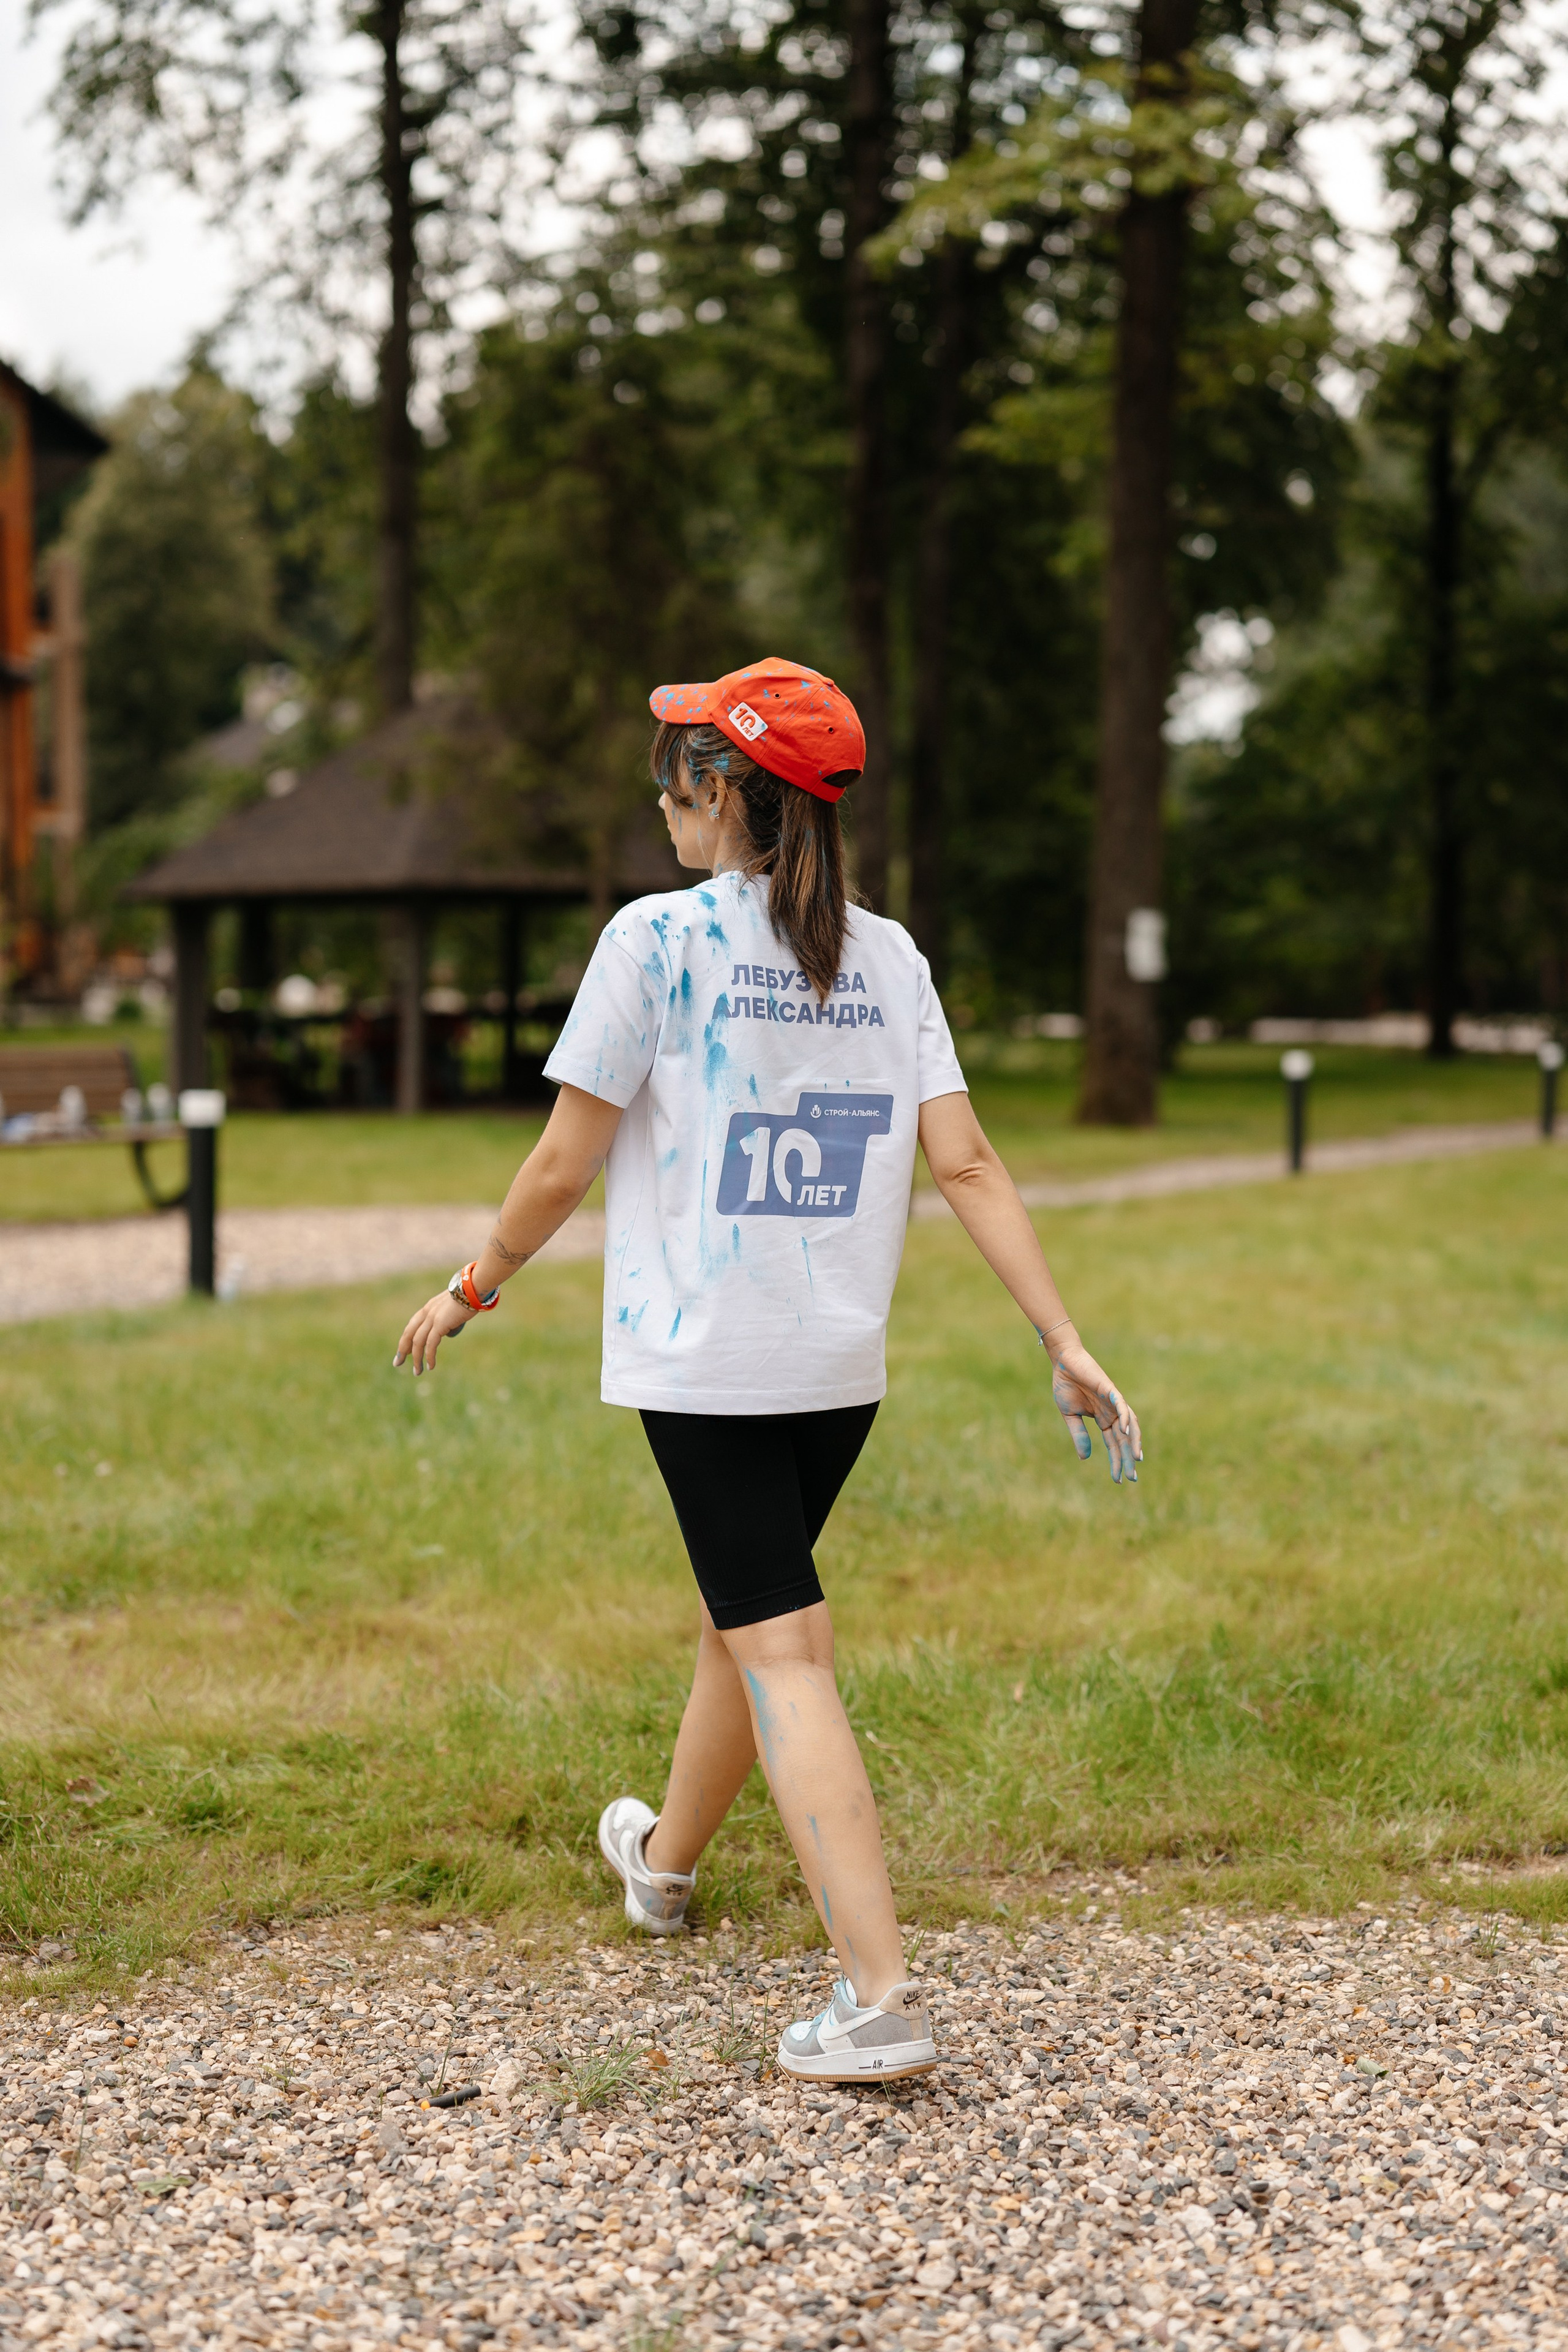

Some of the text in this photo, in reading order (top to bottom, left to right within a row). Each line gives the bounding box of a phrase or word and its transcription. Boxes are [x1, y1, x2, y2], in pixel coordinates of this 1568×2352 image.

[736, 708, 755, 736] 10 ЛЕТ
[731, 965, 867, 993] ЛЕБУЗВА
[712, 996, 886, 1028] АЛЕКСАНДРА
[824, 1108, 880, 1117] СТРОЙ-АЛЬЯНС
[739, 1126, 848, 1205] 10 ЛЕТ
[907, 1990, 919, 1999] NIKE
[872, 2059, 884, 2070] AIR
